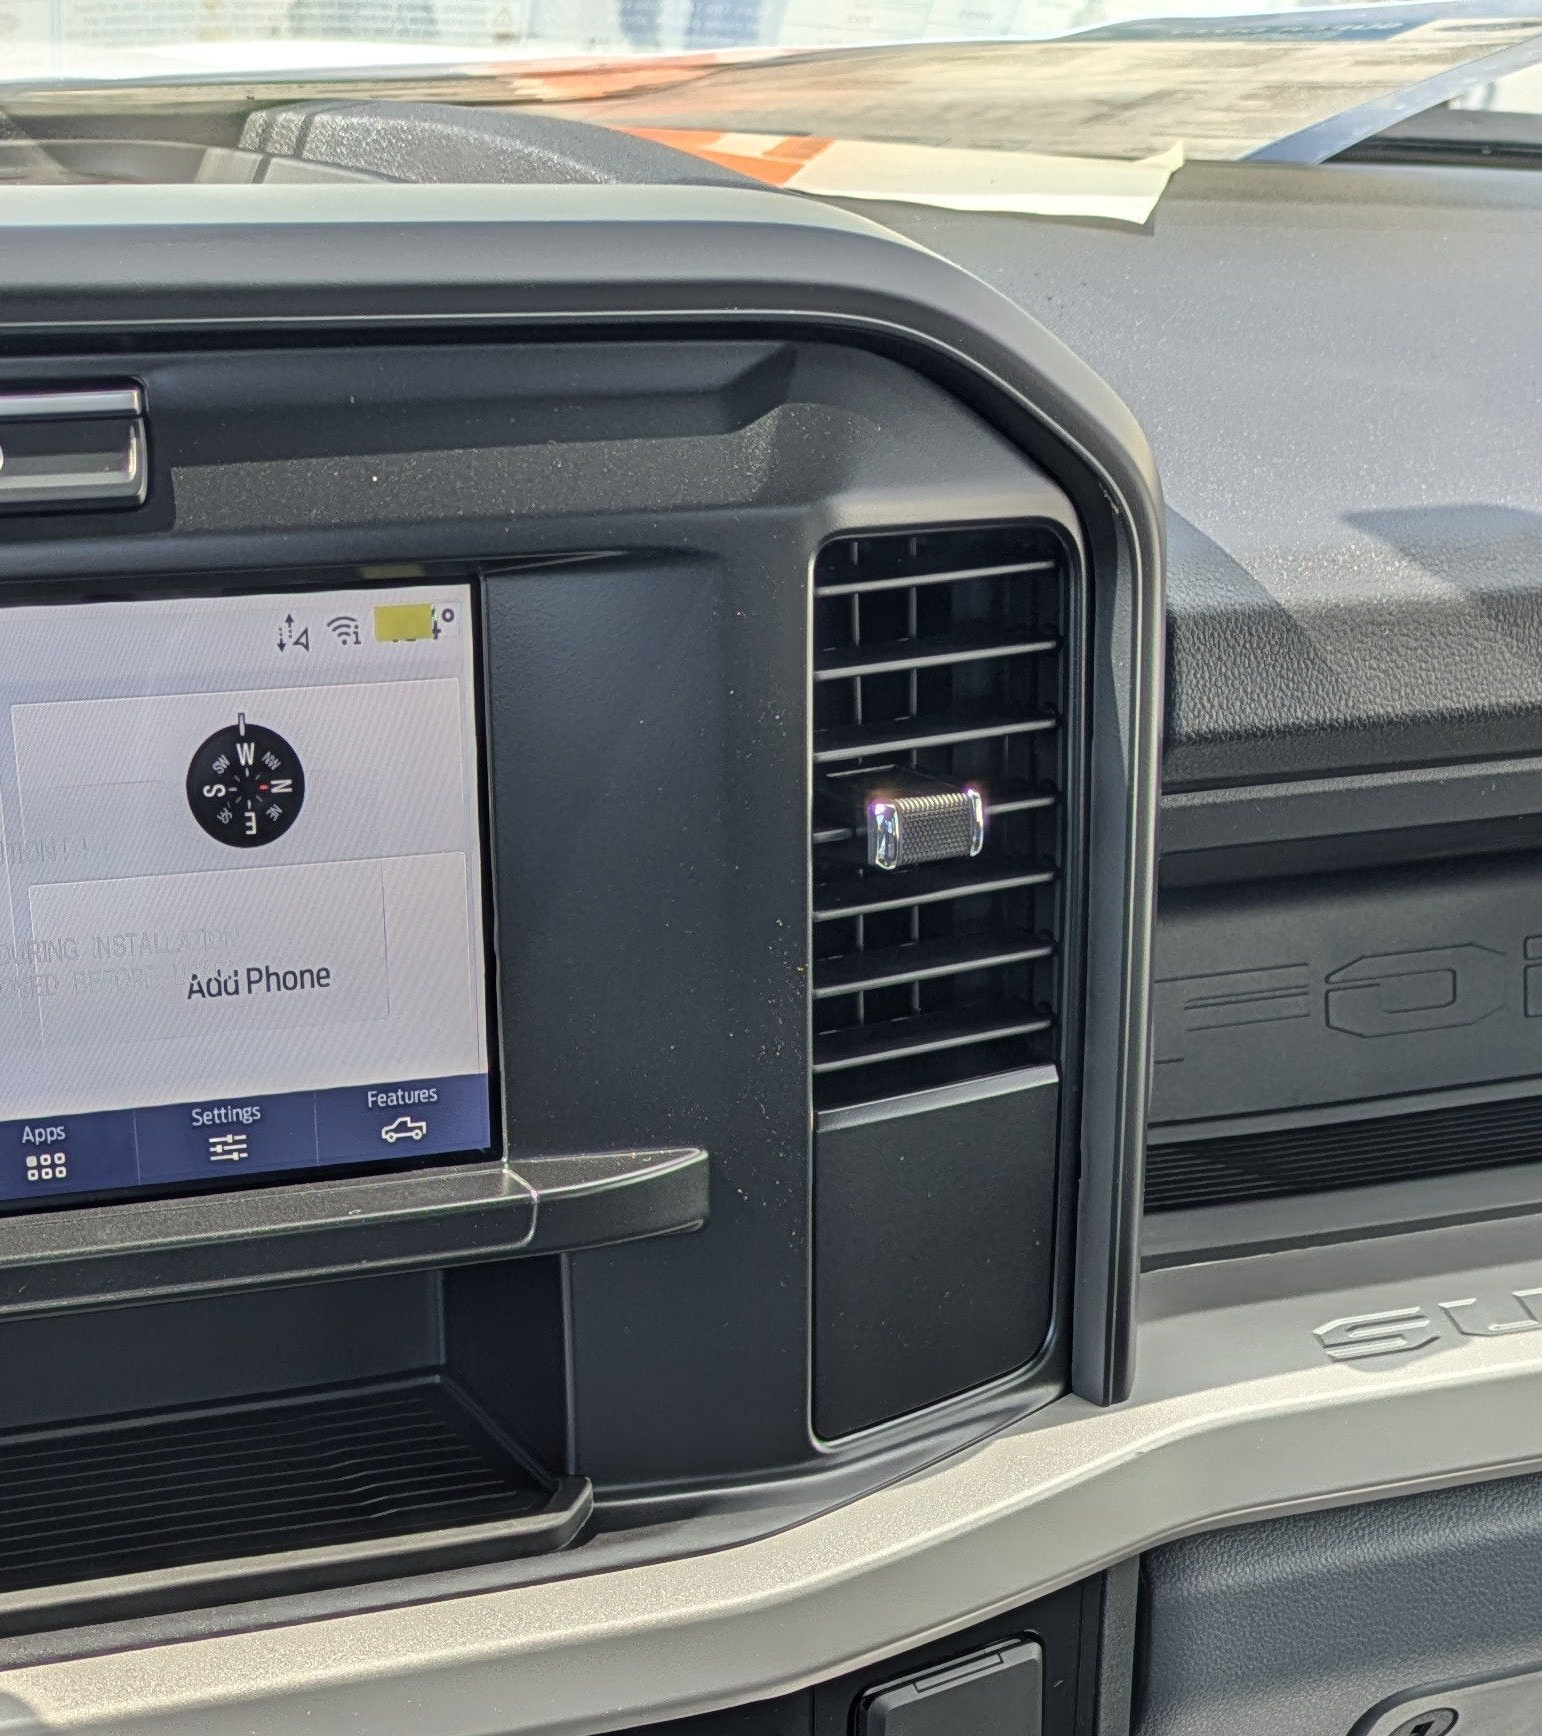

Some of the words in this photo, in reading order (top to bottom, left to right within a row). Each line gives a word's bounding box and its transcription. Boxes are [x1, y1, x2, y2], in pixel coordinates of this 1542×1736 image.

[236, 742, 255, 766] W
[202, 783, 227, 798] S
[270, 779, 293, 794] N
[244, 811, 257, 835] E
[186, 966, 241, 1001] Add
[245, 960, 333, 997] Phone
[367, 1084, 439, 1109] Features
[190, 1101, 262, 1129] Settings
[20, 1123, 67, 1147] Apps
